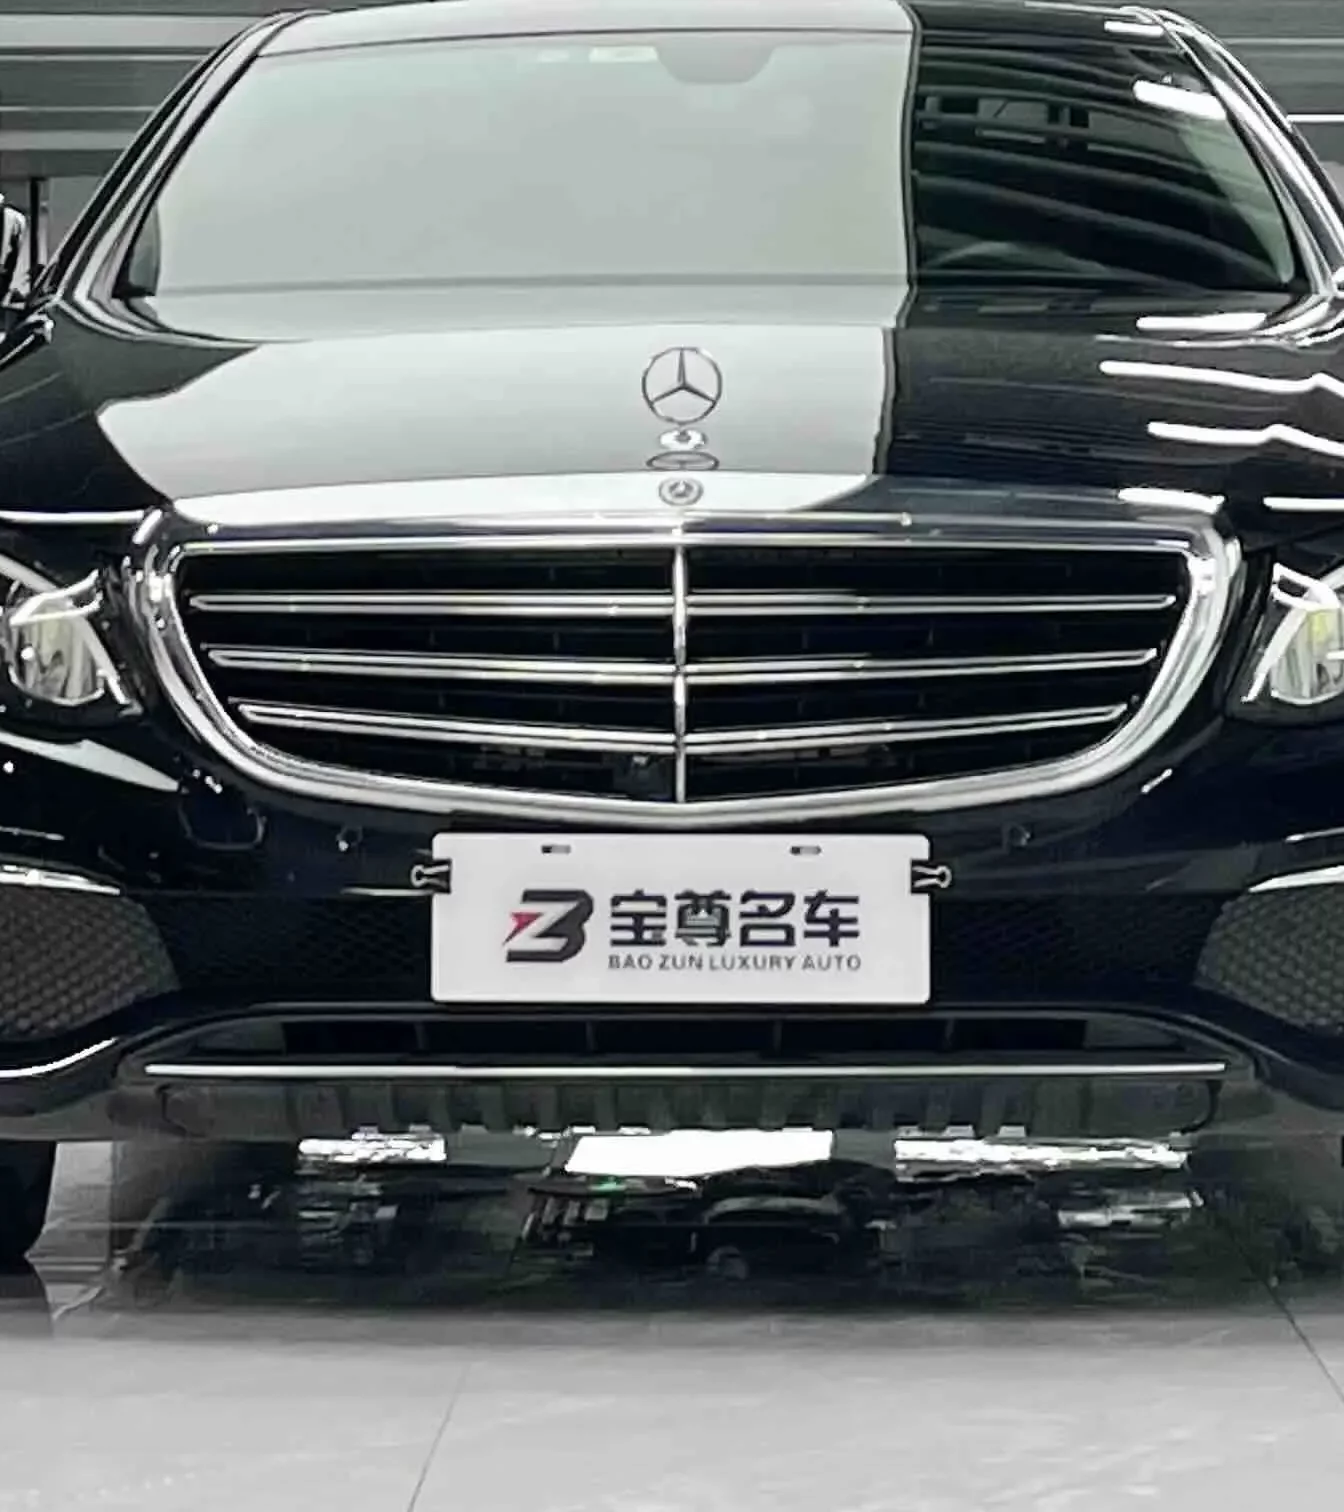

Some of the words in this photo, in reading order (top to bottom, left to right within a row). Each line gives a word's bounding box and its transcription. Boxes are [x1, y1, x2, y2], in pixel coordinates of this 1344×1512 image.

[609, 888, 860, 948] 宝尊名车
[607, 953, 653, 971] BAO
[658, 953, 704, 971] ZUN
[708, 953, 796, 971] LUXURY
[801, 953, 862, 971] AUTO
